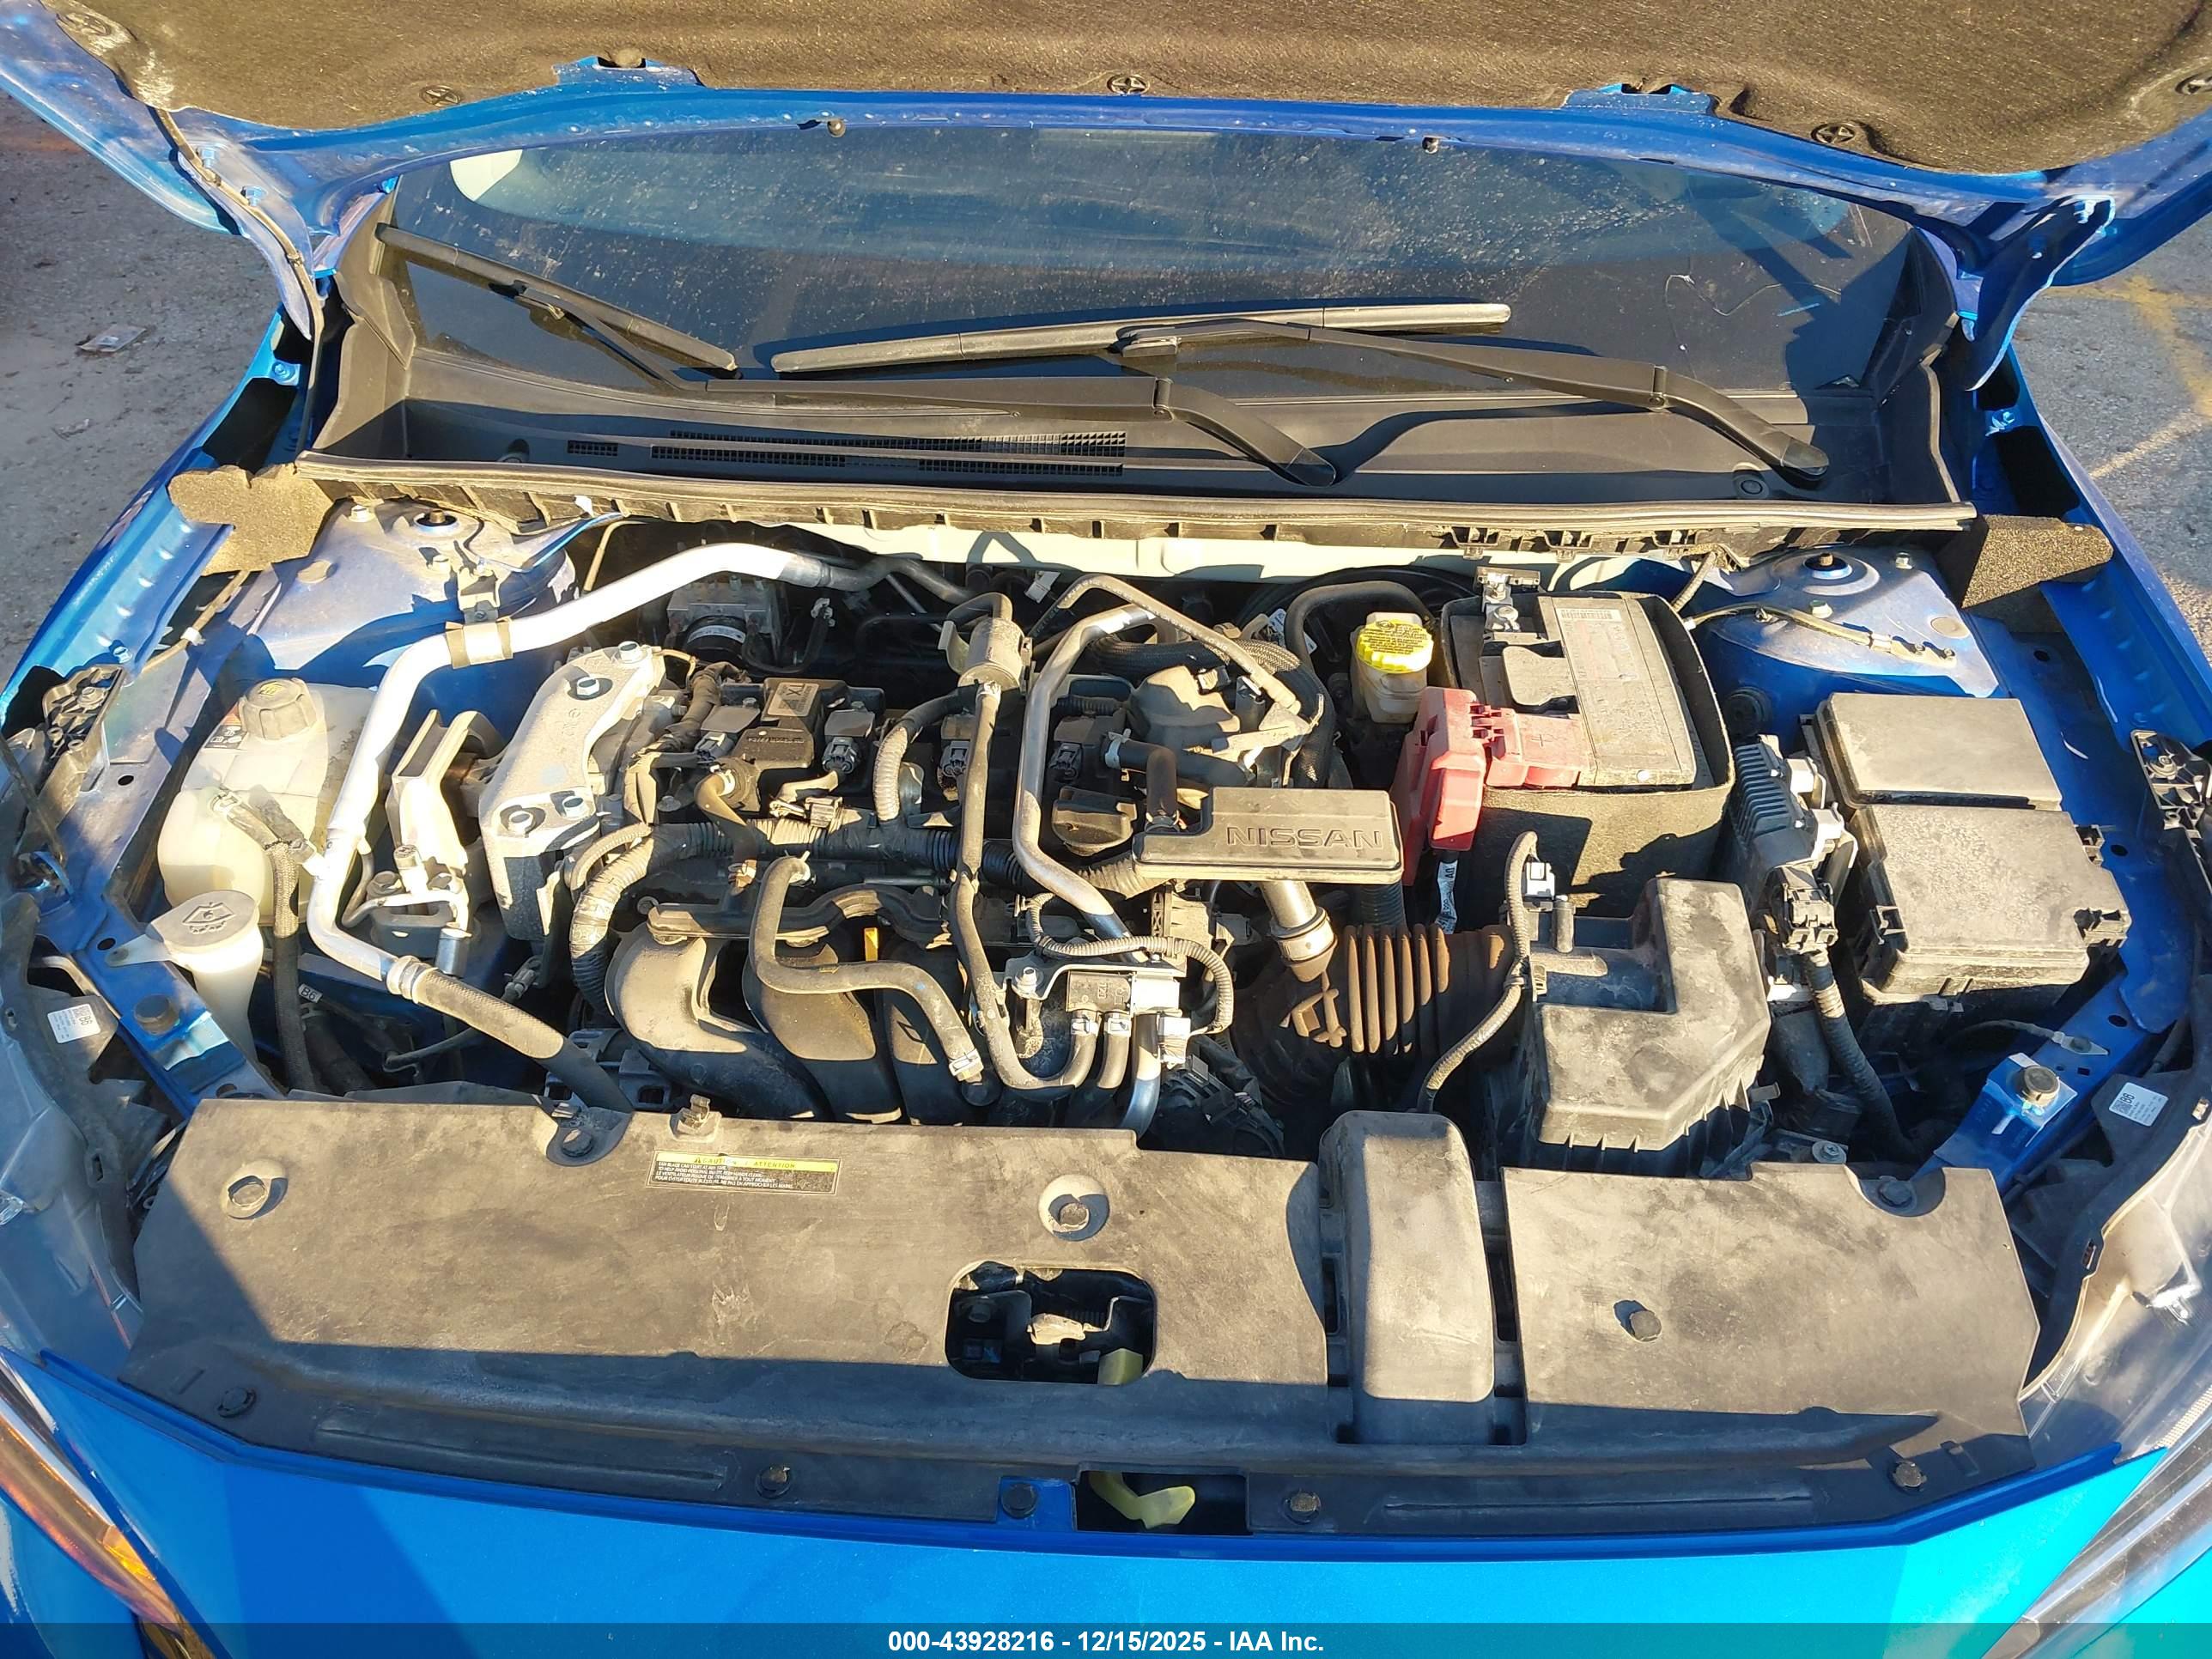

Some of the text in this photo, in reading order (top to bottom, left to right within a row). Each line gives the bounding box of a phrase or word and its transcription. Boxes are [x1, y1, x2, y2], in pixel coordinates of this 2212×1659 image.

[1227, 826, 1384, 848] NISSAN
[301, 987, 317, 1000] B6
[2120, 1093, 2136, 1104] B6
